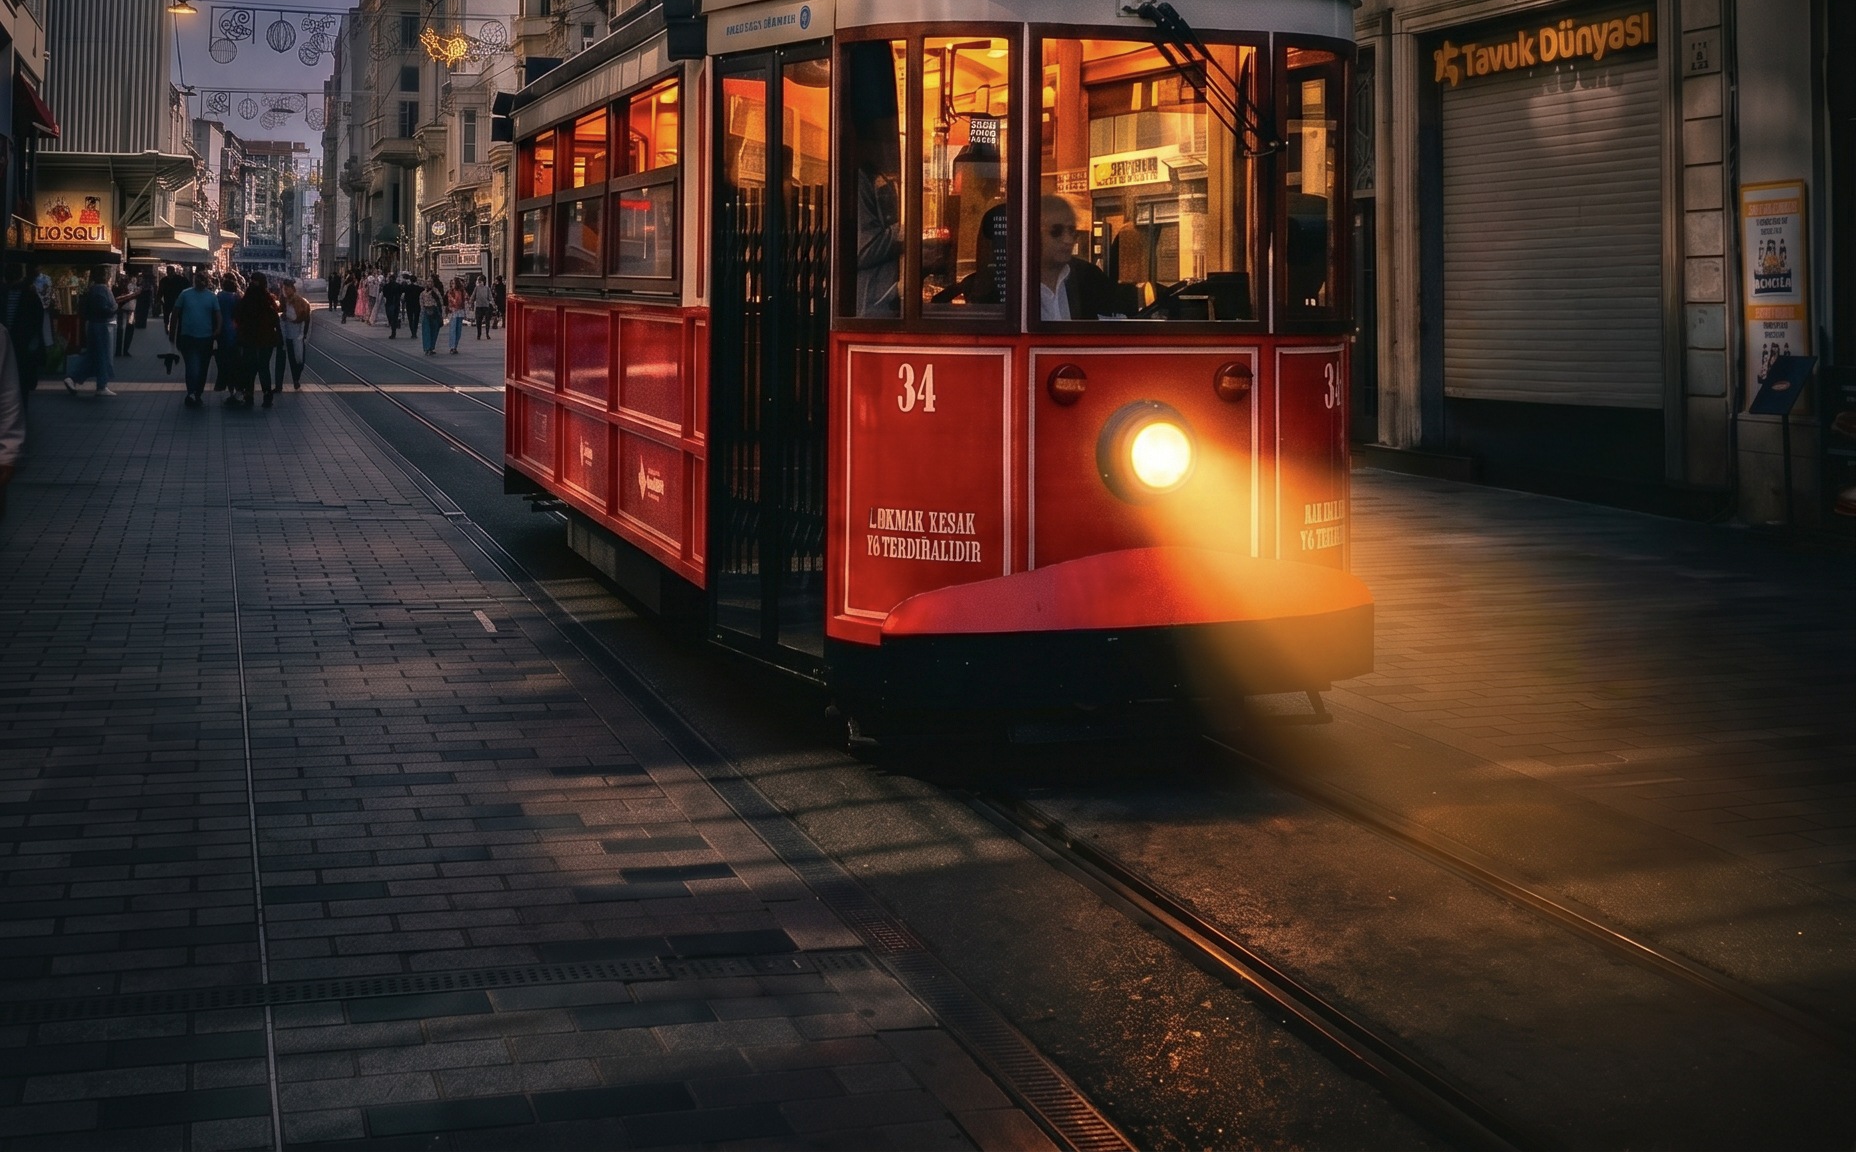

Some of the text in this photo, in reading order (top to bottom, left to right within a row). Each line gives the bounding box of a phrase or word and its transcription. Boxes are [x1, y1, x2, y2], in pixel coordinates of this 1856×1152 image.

[1462, 31, 1535, 77] Tavuk
[1539, 12, 1650, 61] Dünyası
[897, 363, 936, 412] 34
